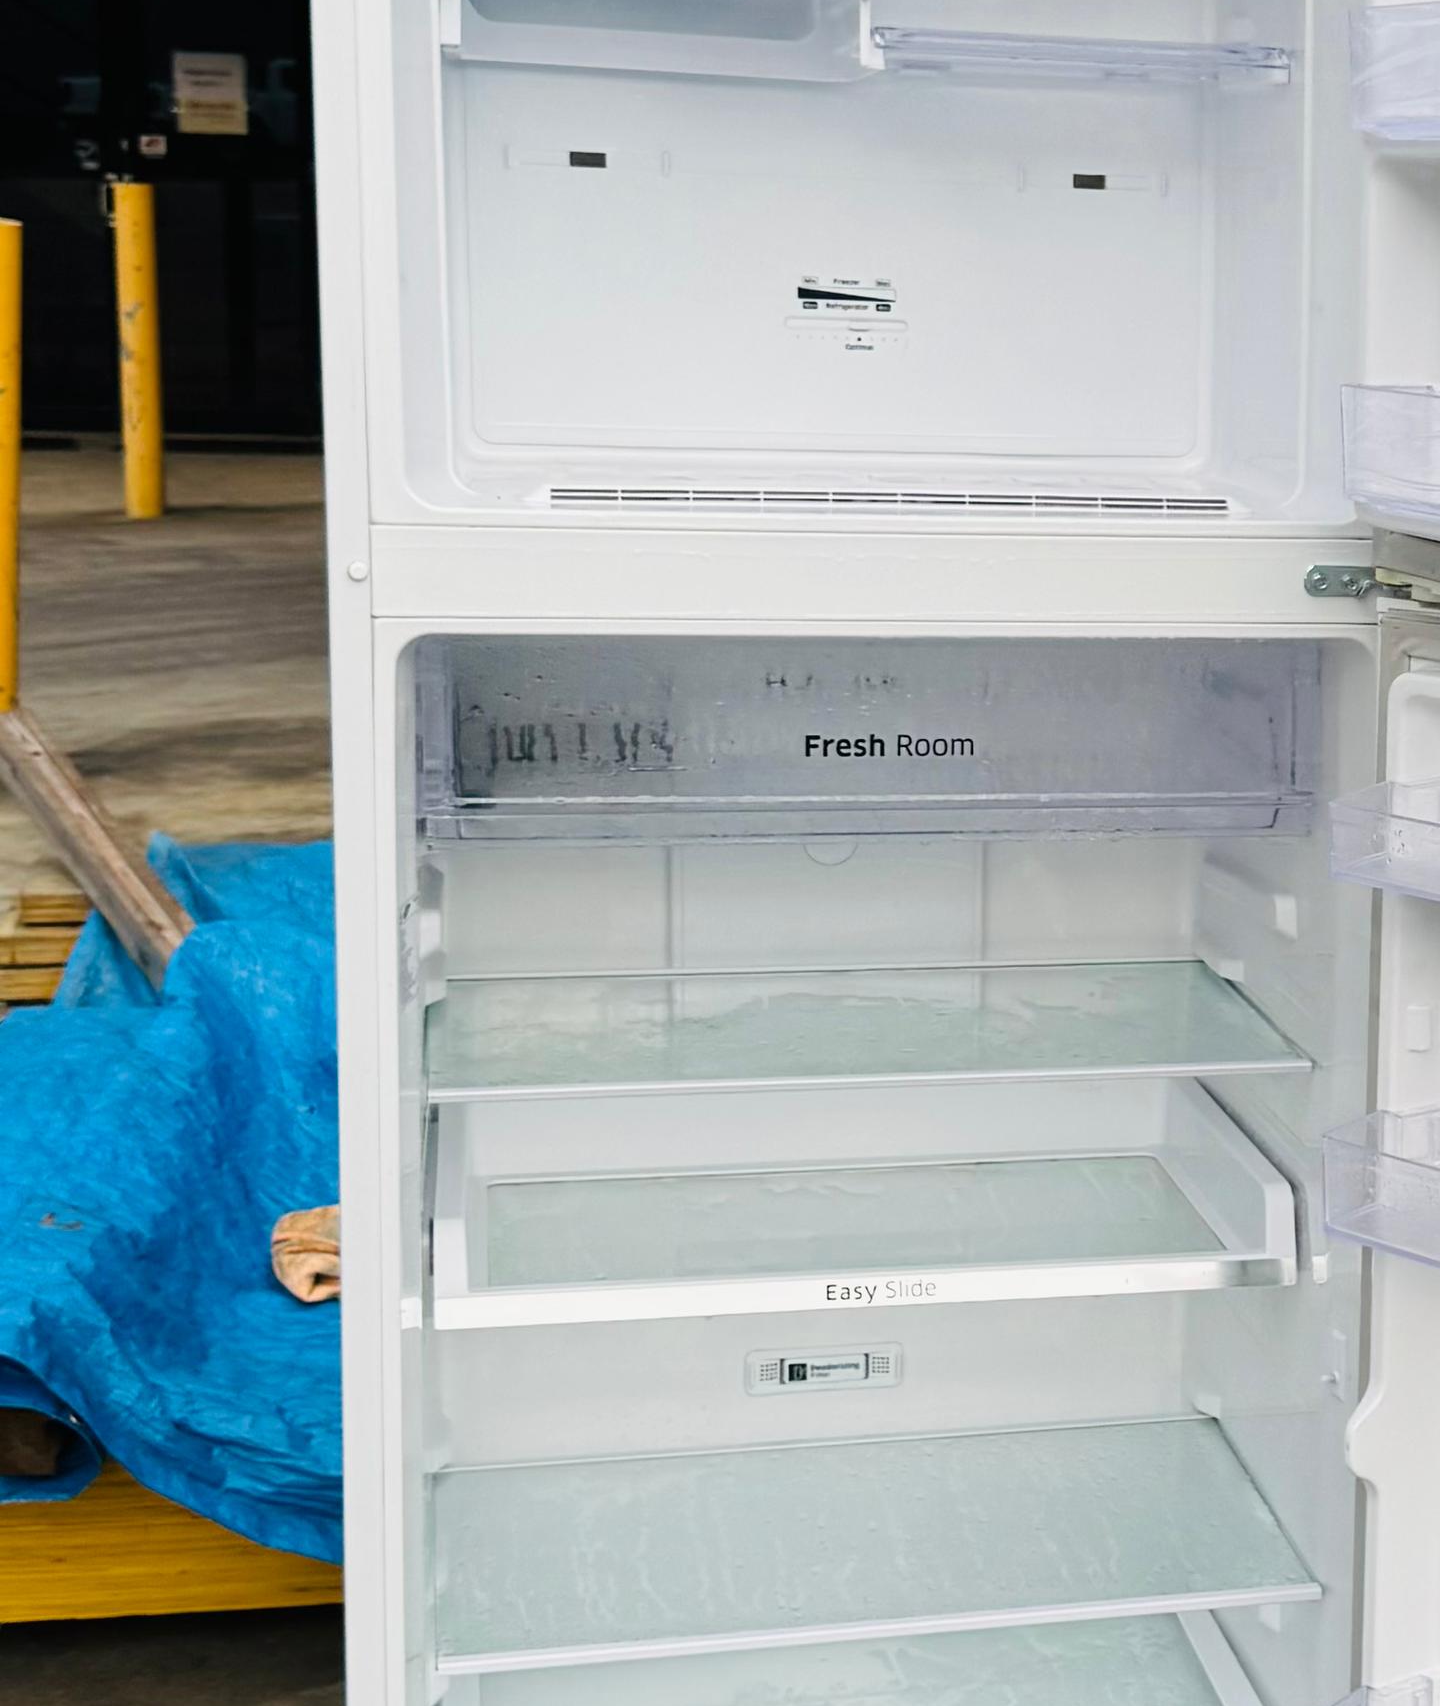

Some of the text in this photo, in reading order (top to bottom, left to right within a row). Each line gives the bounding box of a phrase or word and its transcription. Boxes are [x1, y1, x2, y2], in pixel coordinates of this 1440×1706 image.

[805, 734, 974, 757] Fresh Room
[826, 1279, 937, 1304] Easy Slide
